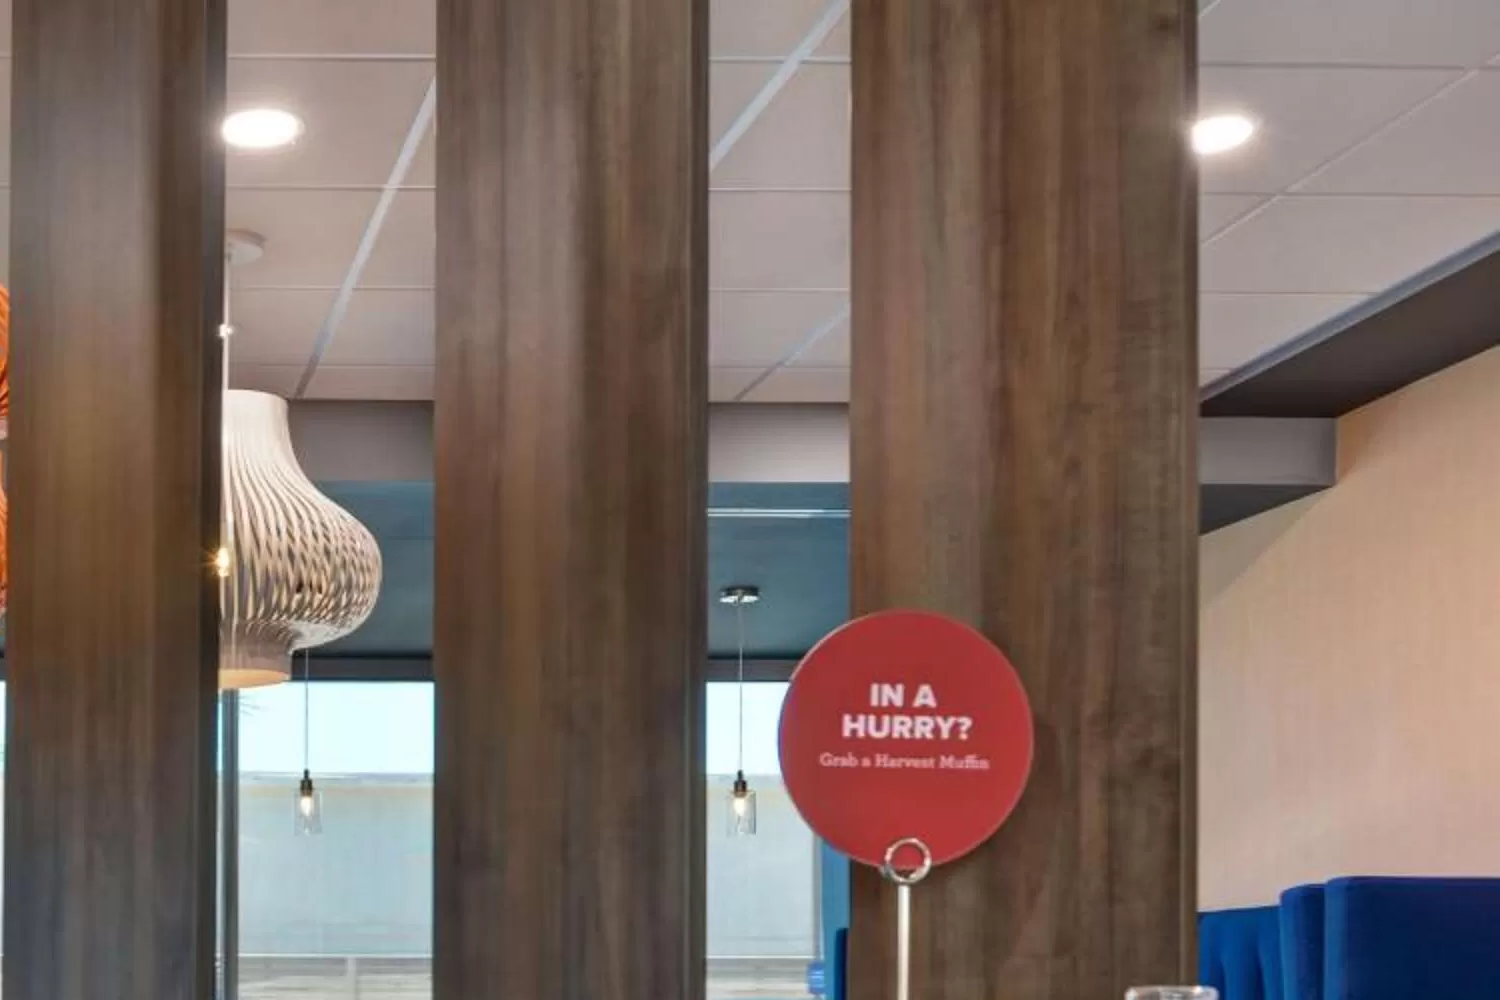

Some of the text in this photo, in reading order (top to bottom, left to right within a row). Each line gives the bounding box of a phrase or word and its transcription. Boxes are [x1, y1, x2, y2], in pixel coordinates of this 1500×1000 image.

[870, 683, 937, 708] IN A
[841, 714, 973, 740] HURRY?
[819, 752, 990, 770] Grab a Harvest Muffin
